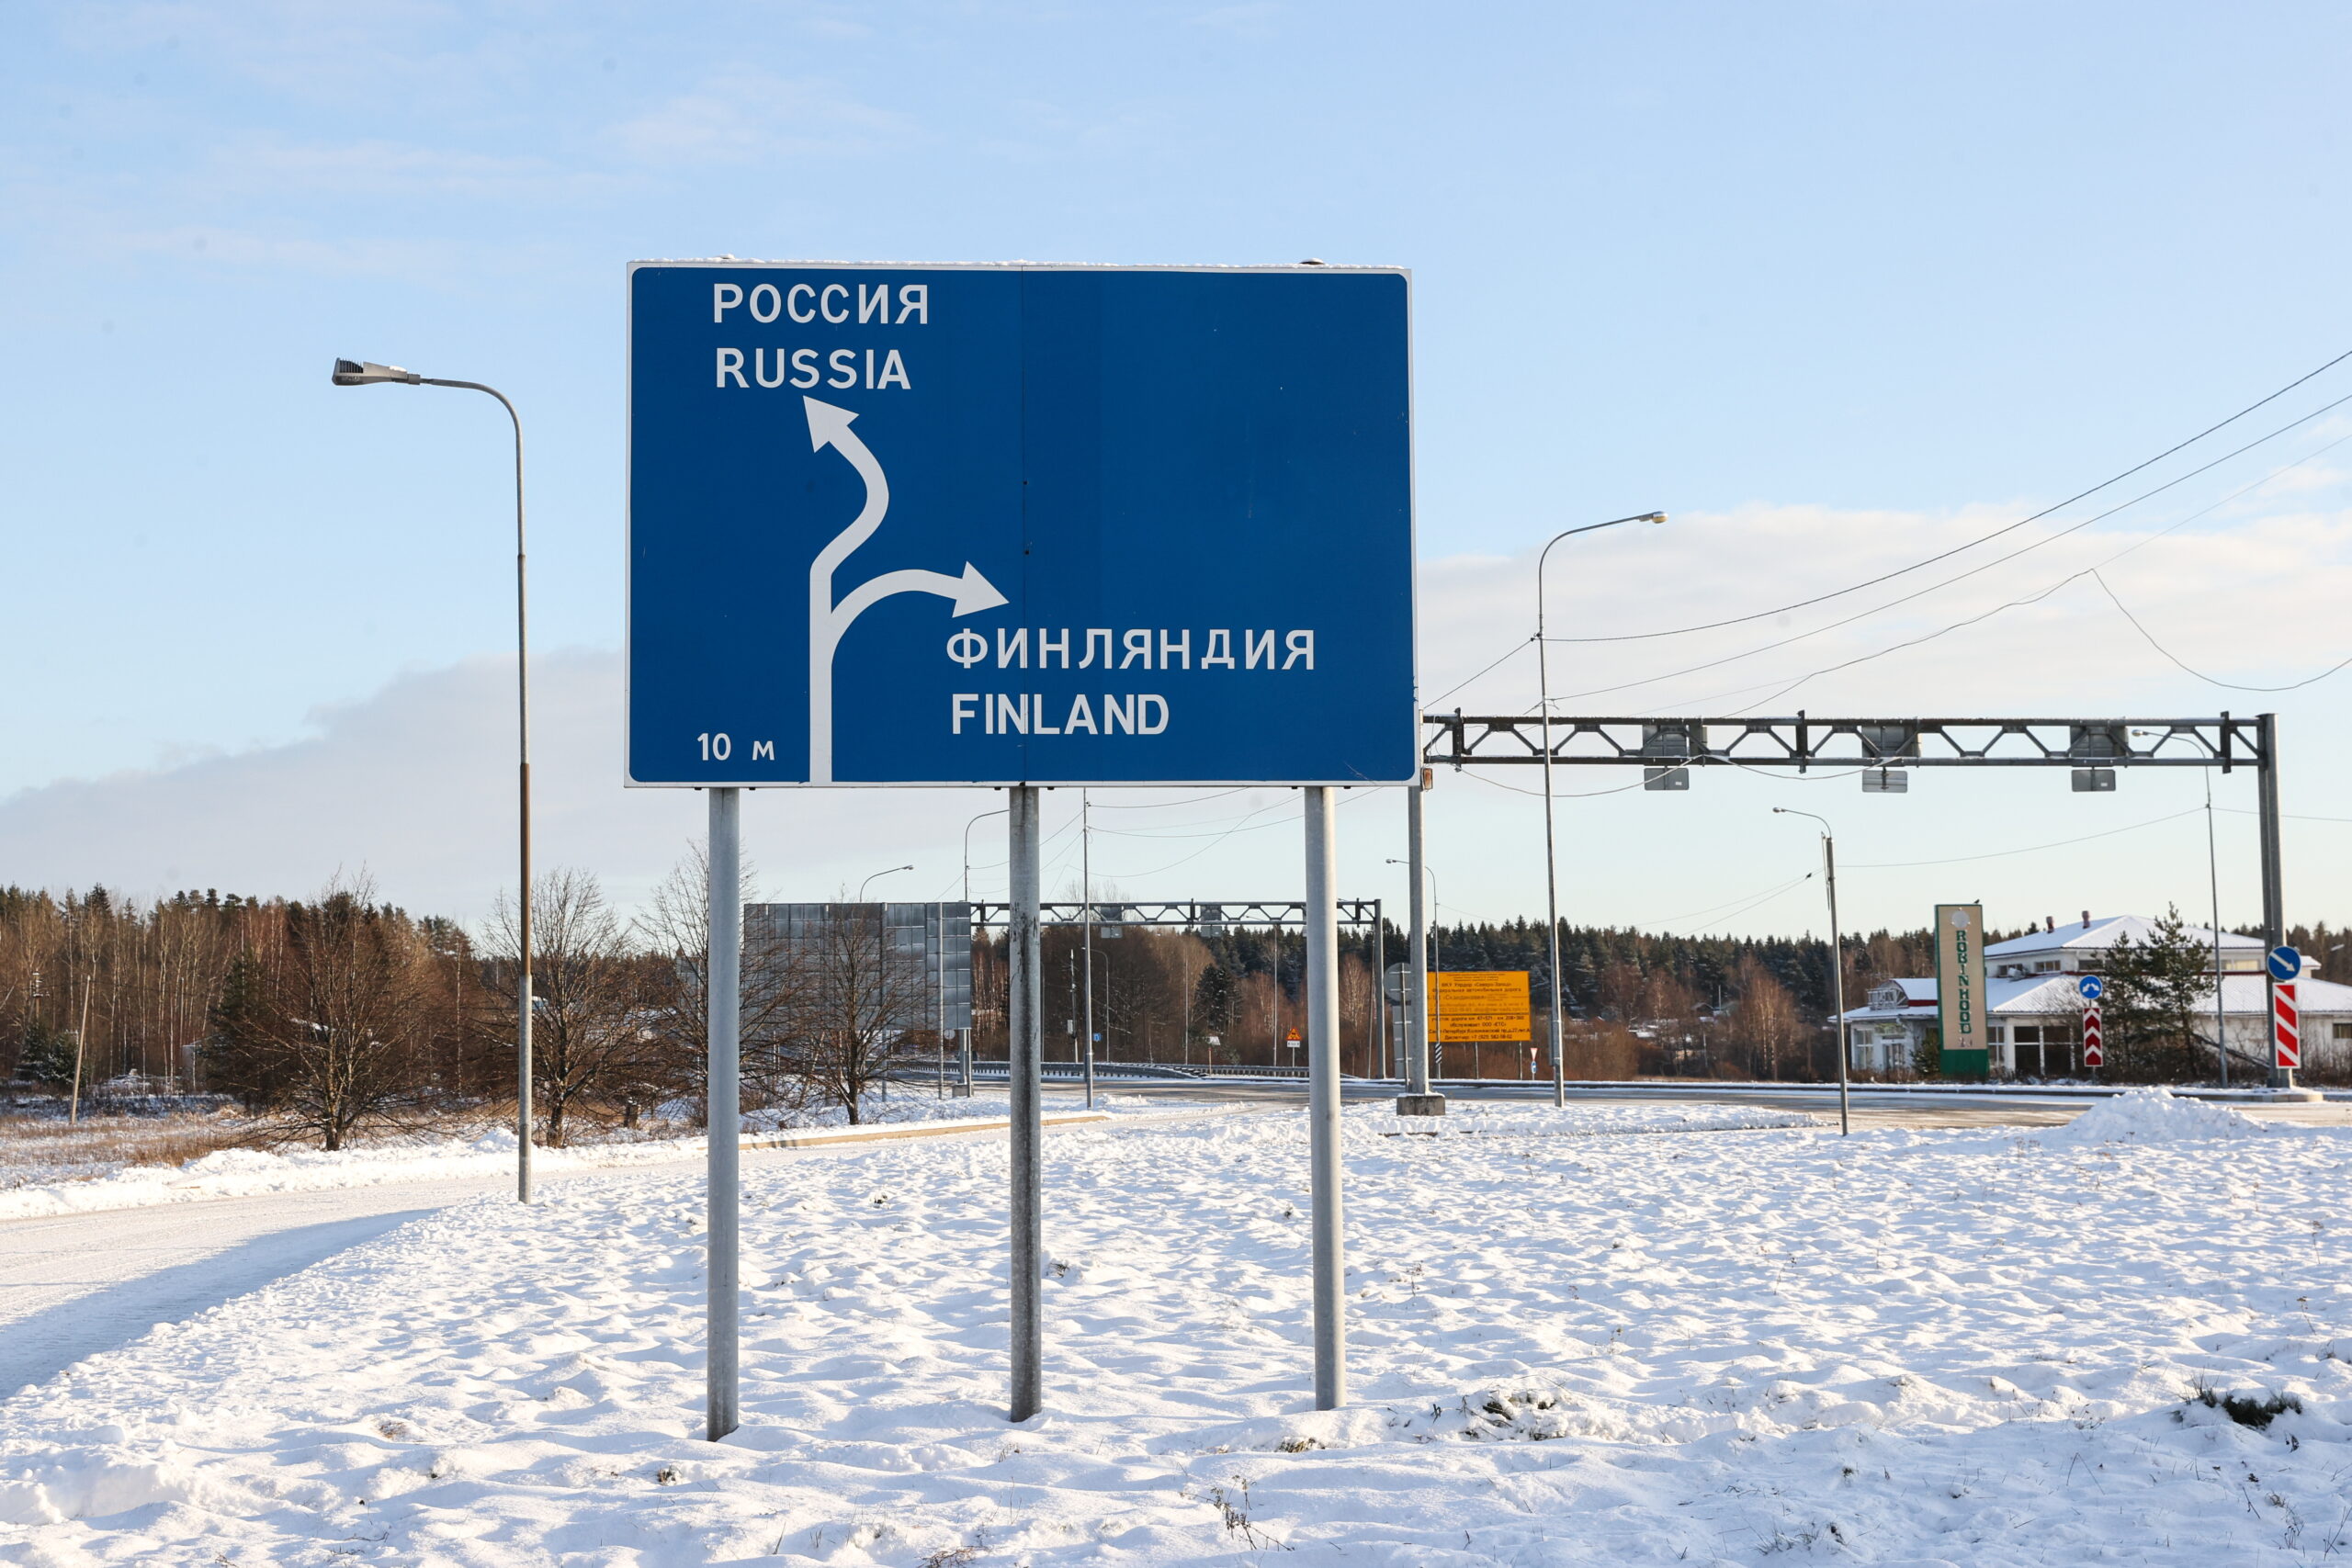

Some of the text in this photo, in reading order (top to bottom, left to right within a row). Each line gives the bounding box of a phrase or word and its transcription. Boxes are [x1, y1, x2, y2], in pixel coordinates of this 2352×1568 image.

[715, 284, 927, 323] РОССИЯ
[718, 348, 910, 389] RUSSIA
[947, 628, 1313, 670] ФИНЛЯНДИЯ
[953, 694, 1169, 734] FINLAND
[698, 733, 730, 760] 10
[1955, 930, 1970, 987] ROBIN
[1959, 988, 1973, 1034] HOOD
